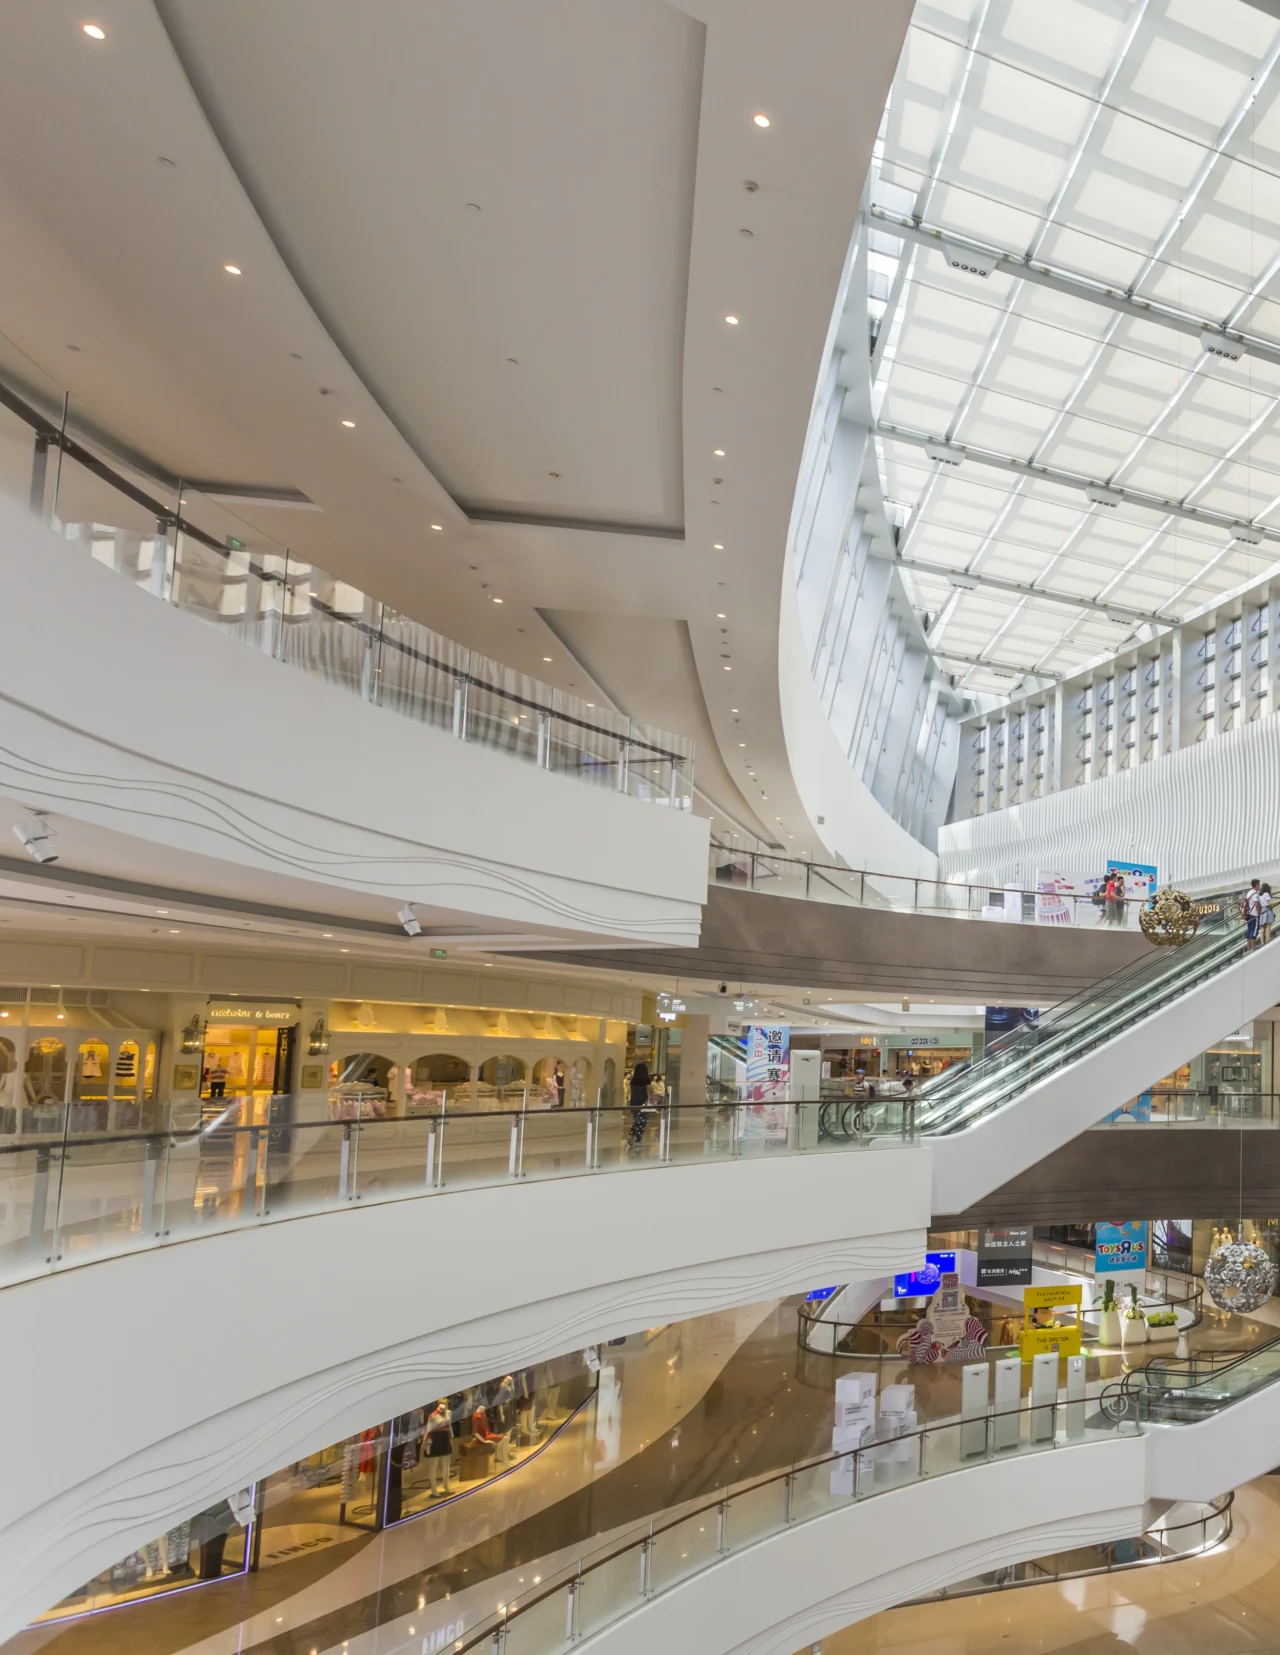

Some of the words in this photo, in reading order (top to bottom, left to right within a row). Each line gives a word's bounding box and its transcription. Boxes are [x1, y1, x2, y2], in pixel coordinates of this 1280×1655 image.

[766, 1030, 783, 1081] 邀请赛
[1111, 1400, 1124, 1410] L3
